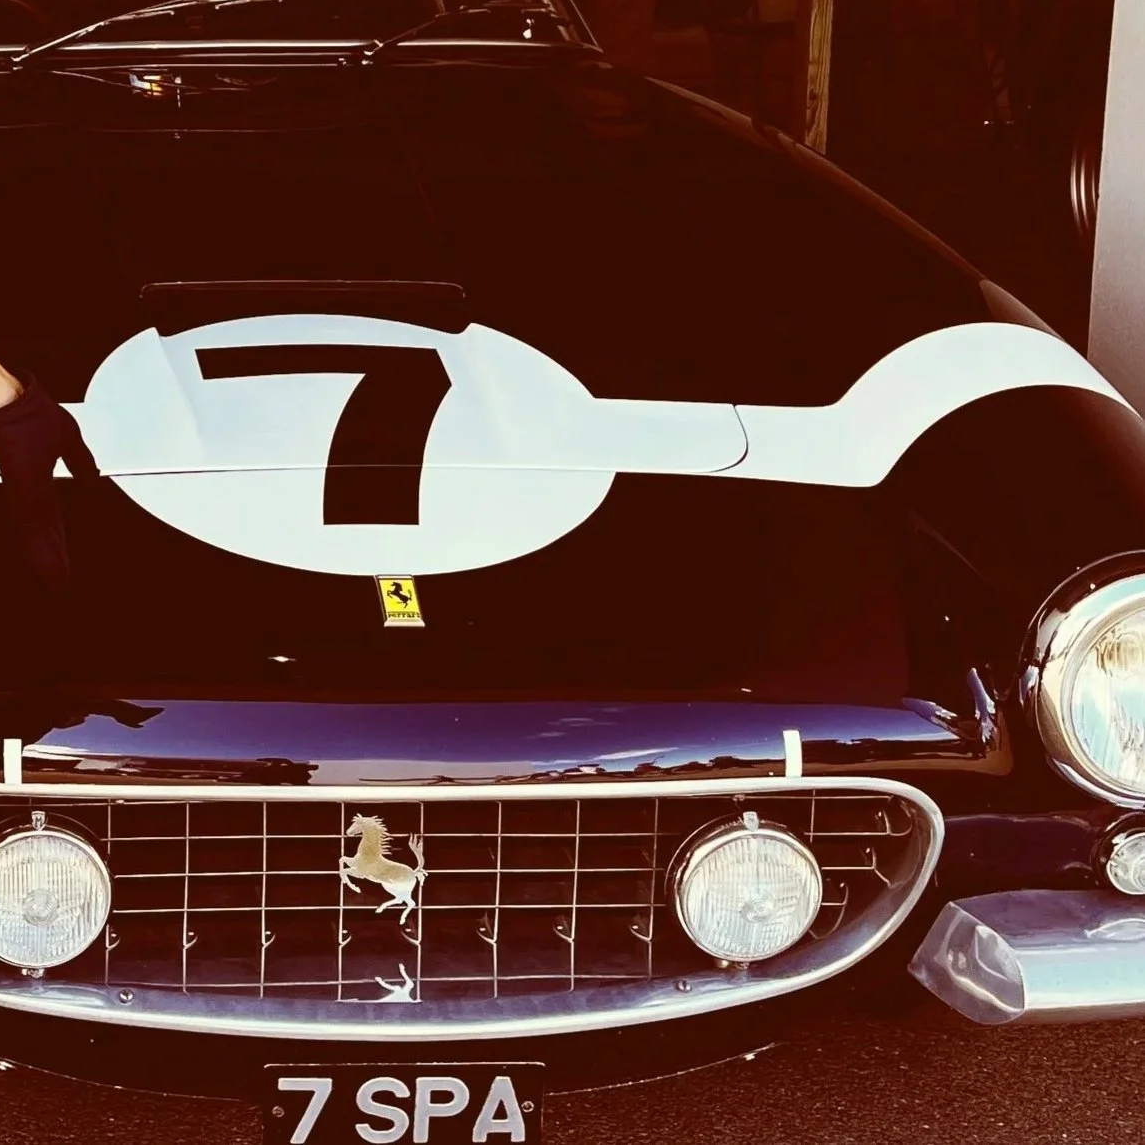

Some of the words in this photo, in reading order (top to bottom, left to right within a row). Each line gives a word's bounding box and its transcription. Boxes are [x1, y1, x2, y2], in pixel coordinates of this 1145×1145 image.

[194, 343, 453, 526] 7
[277, 1077, 333, 1144] 7
[355, 1076, 526, 1144] SPA
